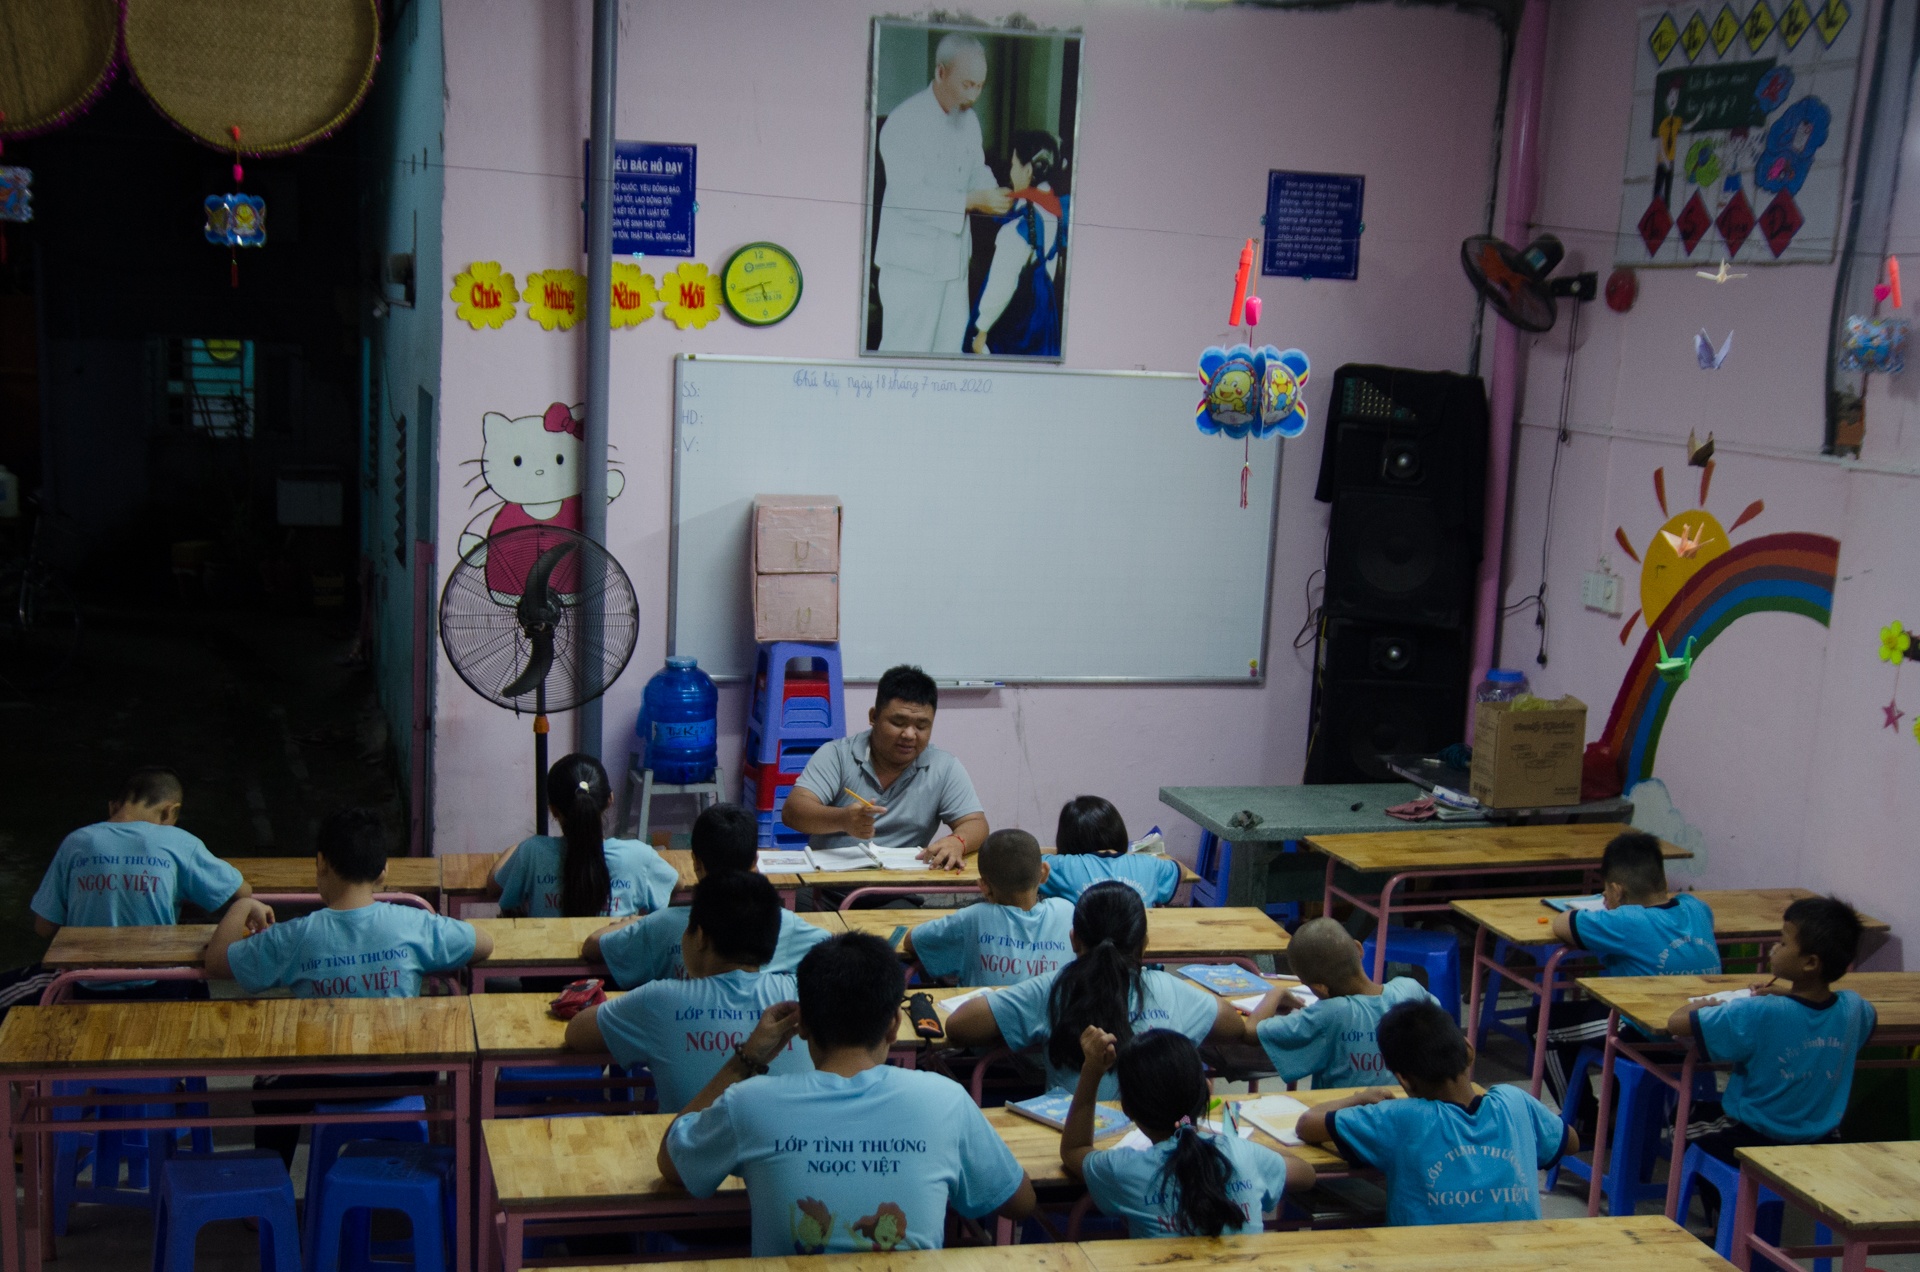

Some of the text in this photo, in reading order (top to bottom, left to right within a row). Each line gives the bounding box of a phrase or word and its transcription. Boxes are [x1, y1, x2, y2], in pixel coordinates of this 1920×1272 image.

[630, 157, 648, 173] BÁC
[650, 156, 663, 174] HỒ
[665, 161, 683, 175] DẠY
[755, 250, 764, 260] 12
[471, 281, 706, 315] Chúc Mừng Năm Mới
[847, 374, 873, 398] ngày
[889, 368, 919, 398] tháng
[921, 376, 930, 391] 7
[931, 379, 958, 392] năm
[93, 852, 120, 865] TÌNH
[125, 855, 171, 869] THƯƠNG
[77, 869, 161, 897] NGỌC VIỆT
[537, 874, 558, 884] LỚP
[999, 935, 1025, 950] TÌNH
[301, 948, 408, 973] LỚP TÌNH THƯƠNG
[980, 954, 1022, 979] NGỌC
[361, 965, 401, 996] VIỆT
[675, 1006, 704, 1021] LỚP
[707, 1006, 743, 1021] TÌNH
[1341, 1029, 1364, 1042] LỚP
[1350, 1052, 1385, 1077] NGỌ
[775, 1135, 927, 1154] LỚP TÌNH THƯƠNG
[807, 1156, 901, 1177] NGỌC VIỆT
[1426, 1160, 1443, 1188] LỚP
[1444, 1144, 1477, 1162] TÌNH
[1427, 1183, 1530, 1208] NGỌC VIỆT
